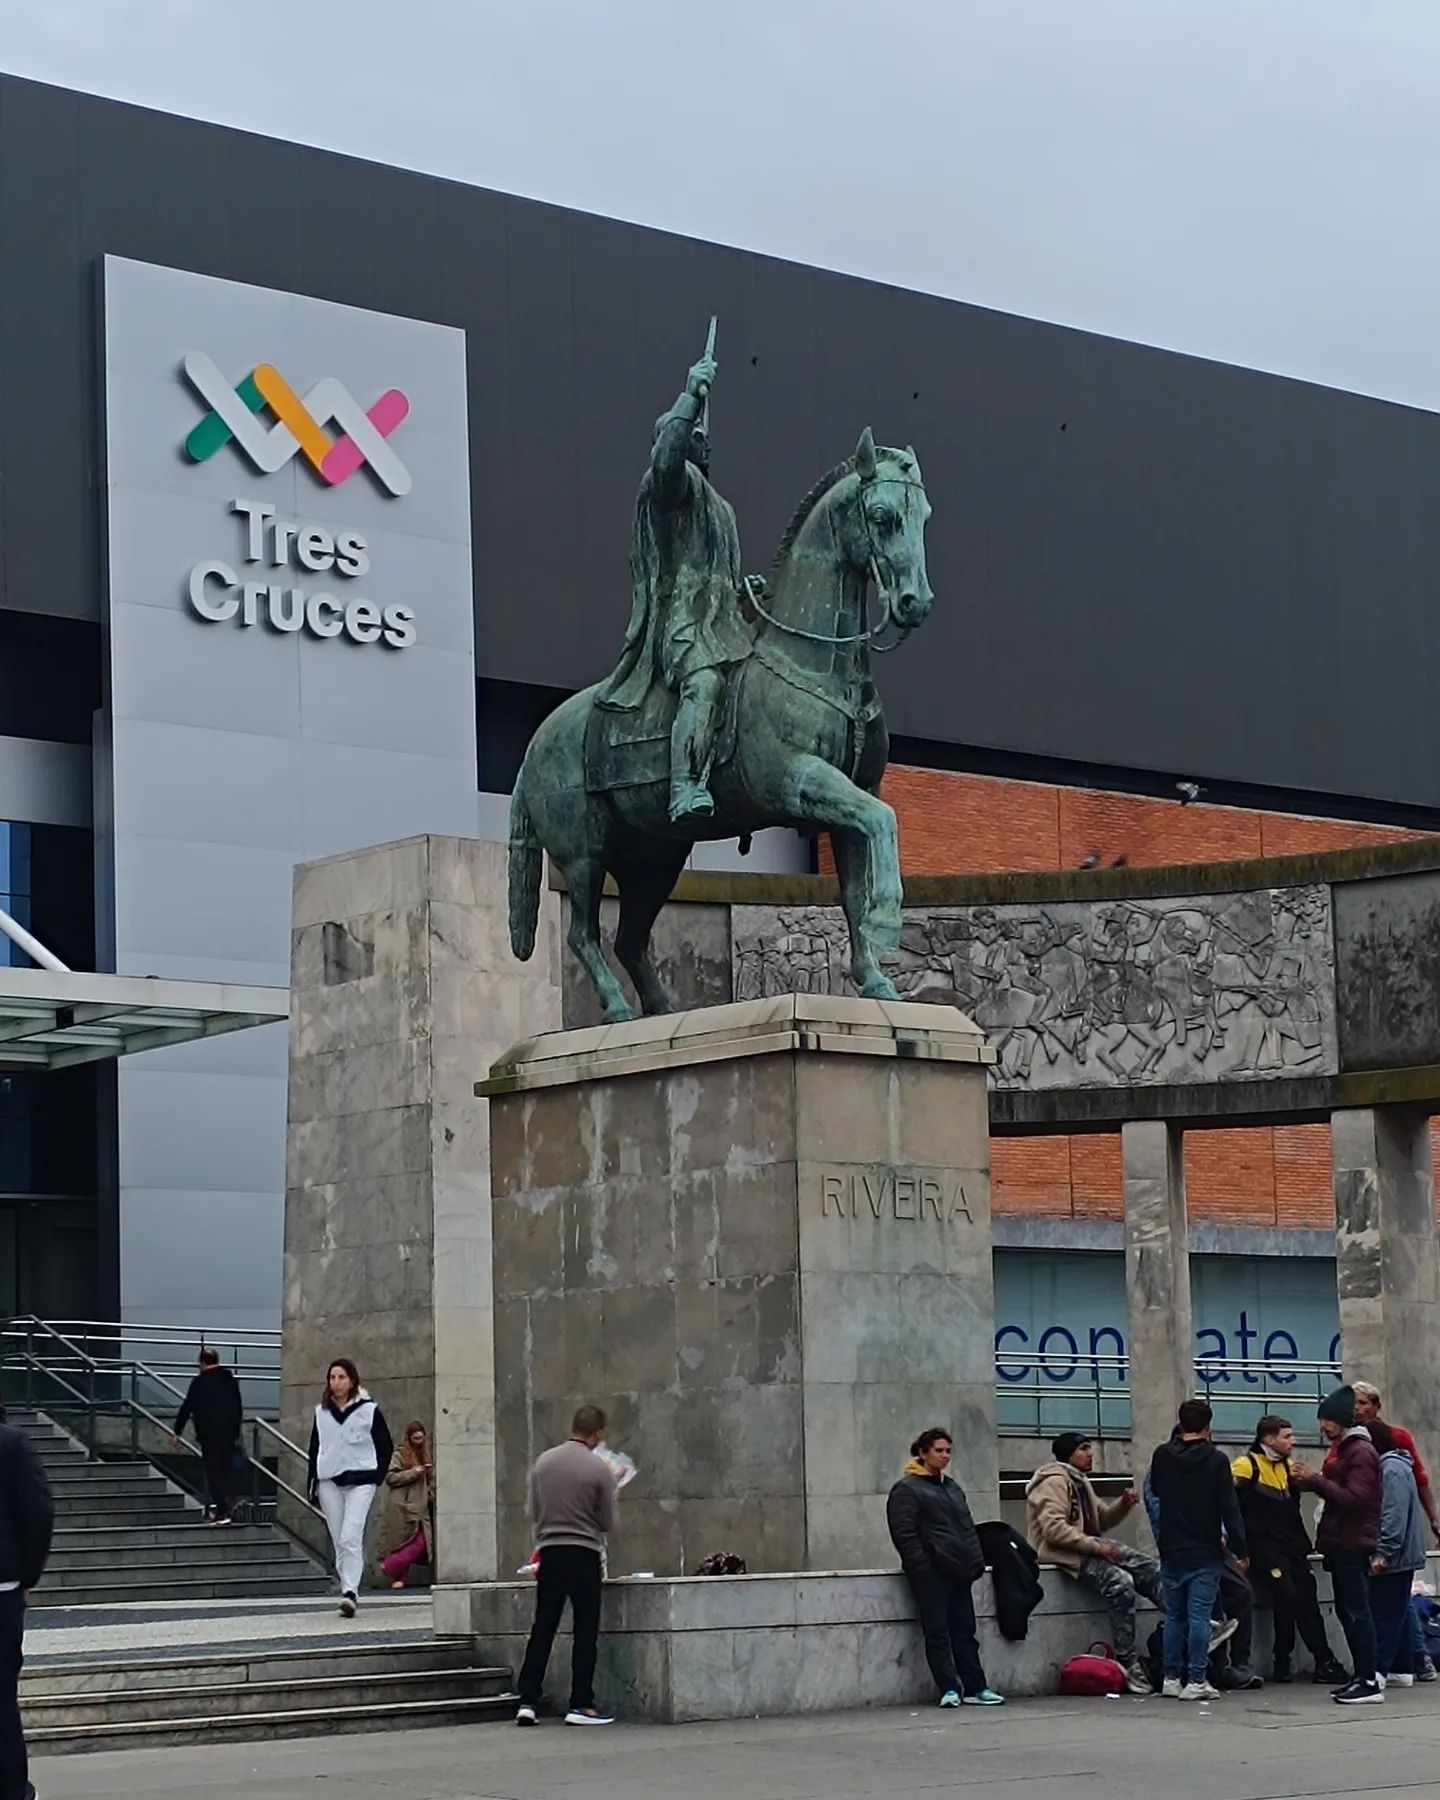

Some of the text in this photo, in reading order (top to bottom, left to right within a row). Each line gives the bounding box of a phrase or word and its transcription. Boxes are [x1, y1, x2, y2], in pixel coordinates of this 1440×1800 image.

[230, 500, 370, 577] Tres
[189, 560, 417, 648] Cruces
[821, 1174, 974, 1224] RIVERA
